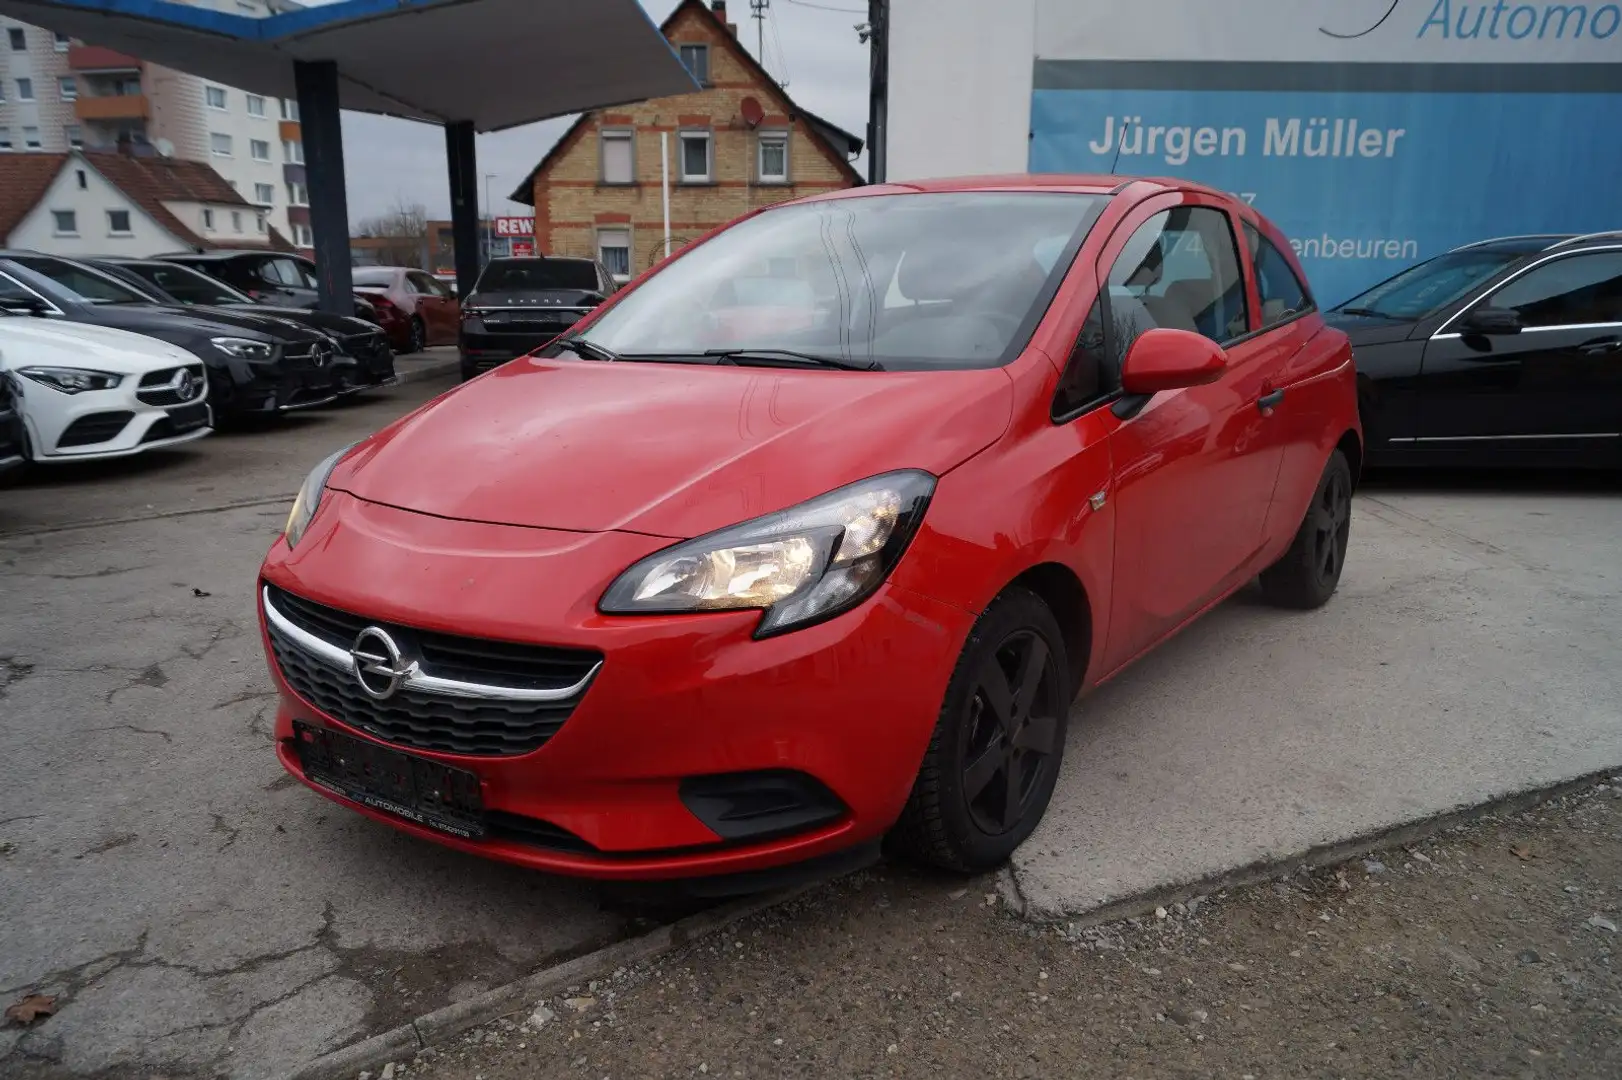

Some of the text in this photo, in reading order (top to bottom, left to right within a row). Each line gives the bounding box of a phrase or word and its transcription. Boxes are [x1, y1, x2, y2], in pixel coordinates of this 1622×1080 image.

[1416, 0, 1621, 39] Automo
[1089, 116, 1405, 165] Jürgen Müller
[364, 797, 424, 823] AUTOMOBILE
